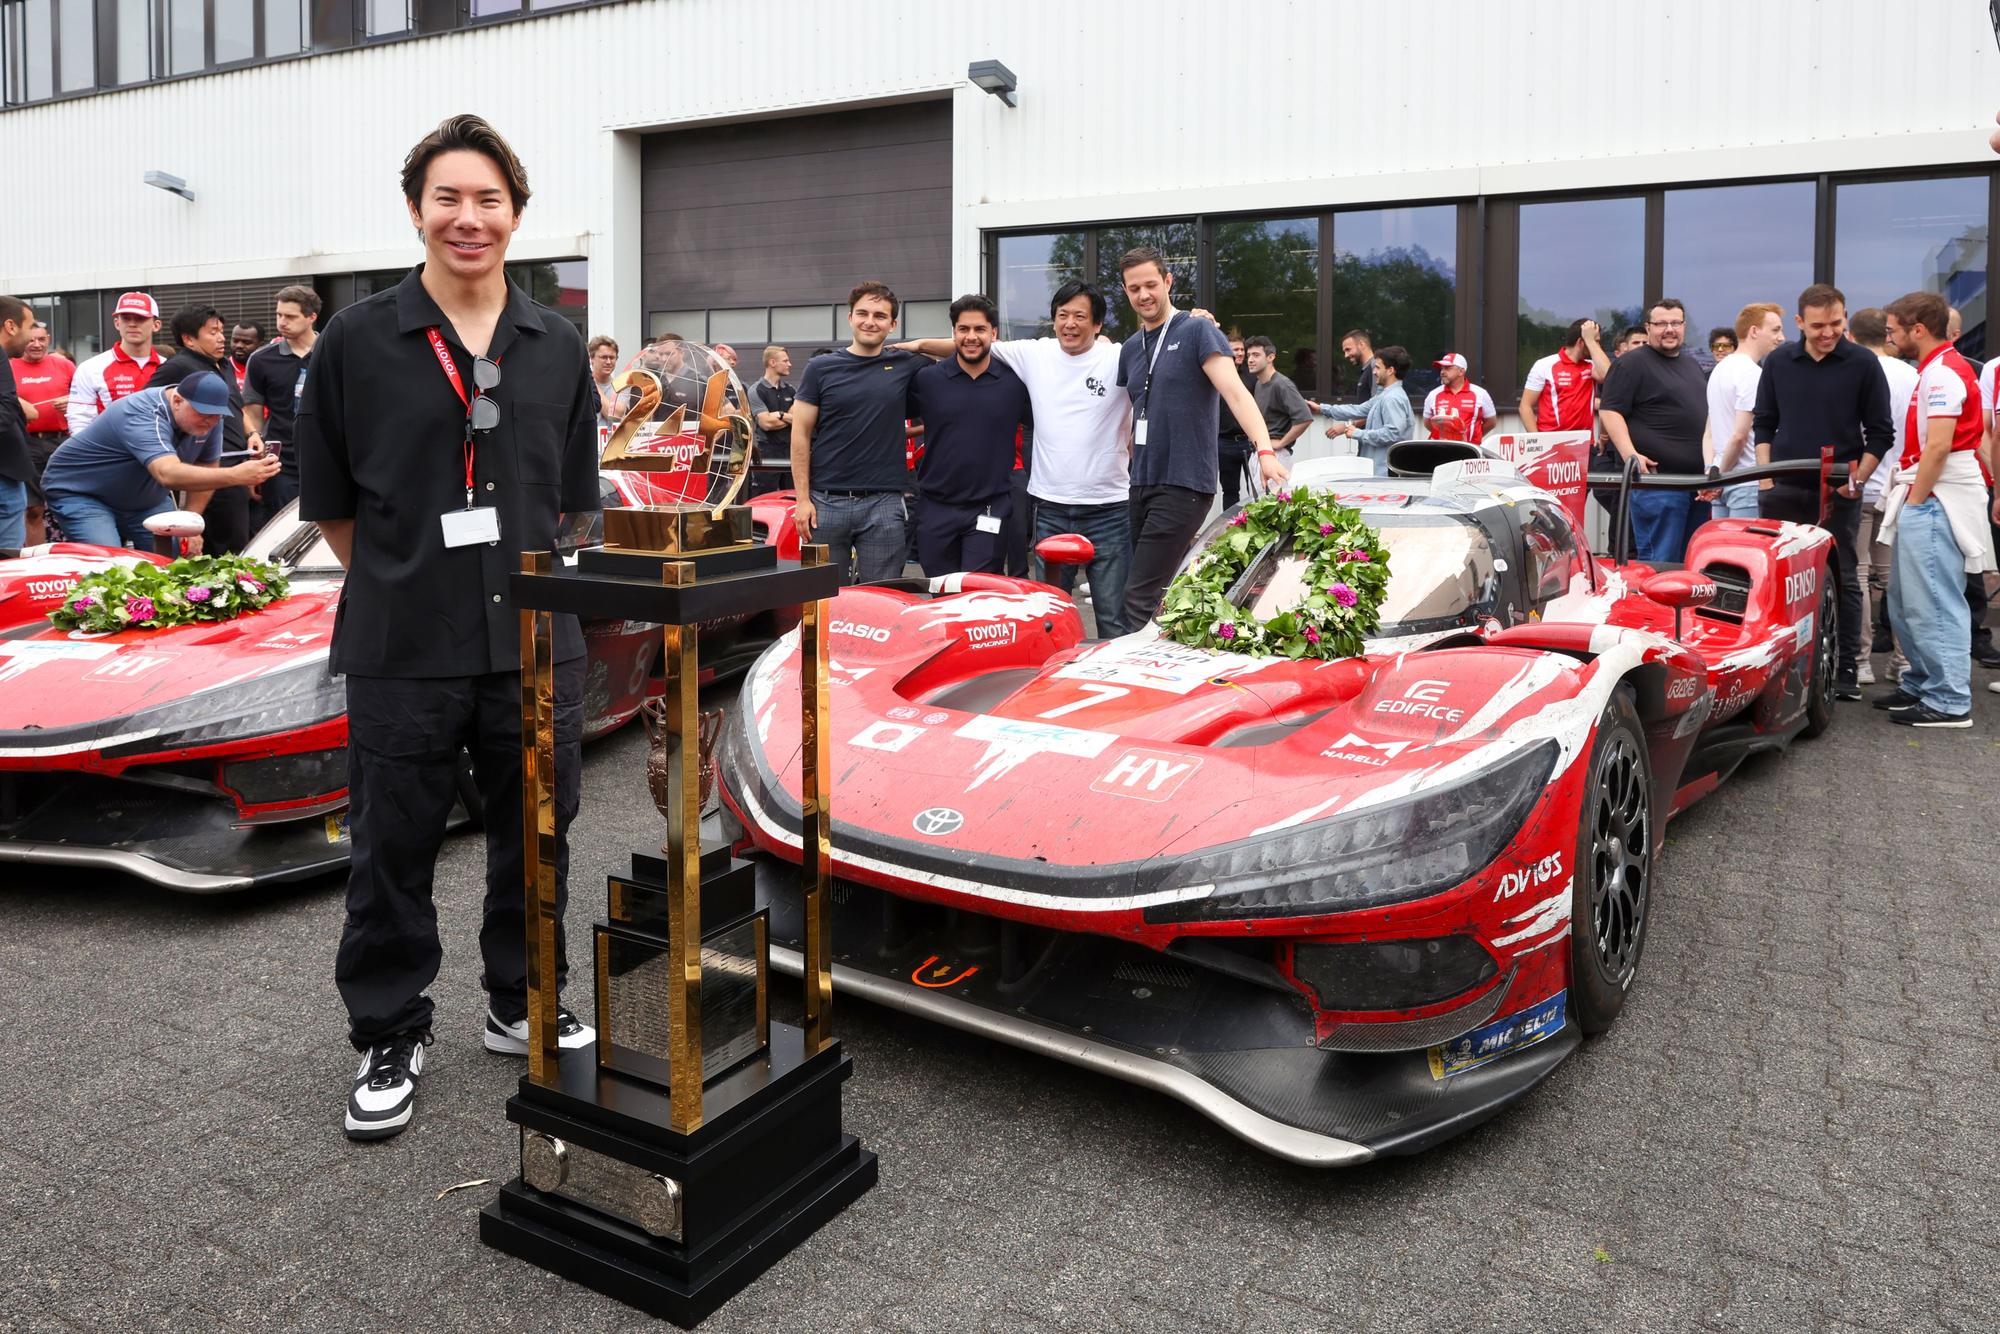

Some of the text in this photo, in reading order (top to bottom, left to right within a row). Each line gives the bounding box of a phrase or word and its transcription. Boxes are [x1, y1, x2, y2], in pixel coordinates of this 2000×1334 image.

[434, 340, 457, 377] TOYOTA
[1465, 461, 1491, 475] TOYOTA
[1546, 461, 1581, 485] TOYOTA
[26, 578, 78, 594] TOYOTA
[29, 592, 69, 600] RACIN
[1691, 583, 1718, 598] DENSO
[1785, 567, 1816, 605] DENSO
[828, 620, 891, 643] CASIO
[965, 623, 1010, 642] TOYOTA
[968, 638, 1011, 650] RACING
[1035, 683, 1131, 719] 7
[1374, 699, 1465, 723] EDIFICE
[1320, 749, 1390, 767] MARELLI
[1102, 755, 1191, 791] HY
[1478, 1005, 1558, 1054] MICELIN
